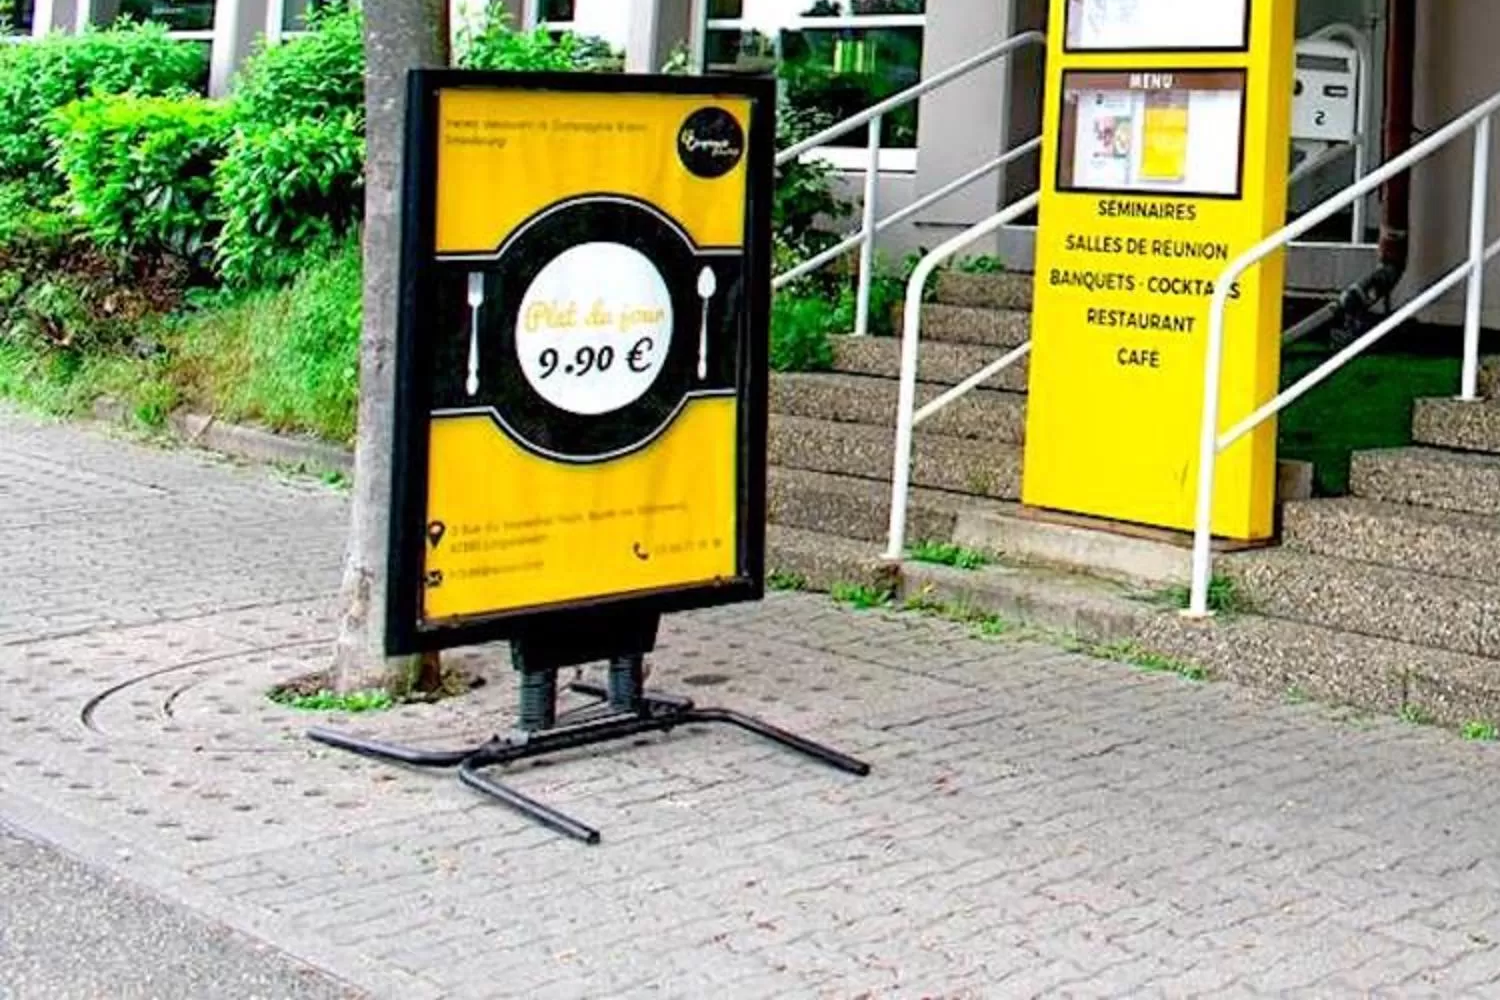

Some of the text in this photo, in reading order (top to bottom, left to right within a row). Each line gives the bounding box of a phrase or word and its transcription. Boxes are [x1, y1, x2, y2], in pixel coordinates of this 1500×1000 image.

[1129, 73, 1174, 88] MENU
[1065, 233, 1122, 254] SALLES
[1126, 237, 1148, 255] DE
[1050, 268, 1135, 291] BANQUETS
[1147, 274, 1241, 299] COCKTAS
[1087, 307, 1195, 332] RESTAURANT
[538, 335, 654, 380] 9.90 €
